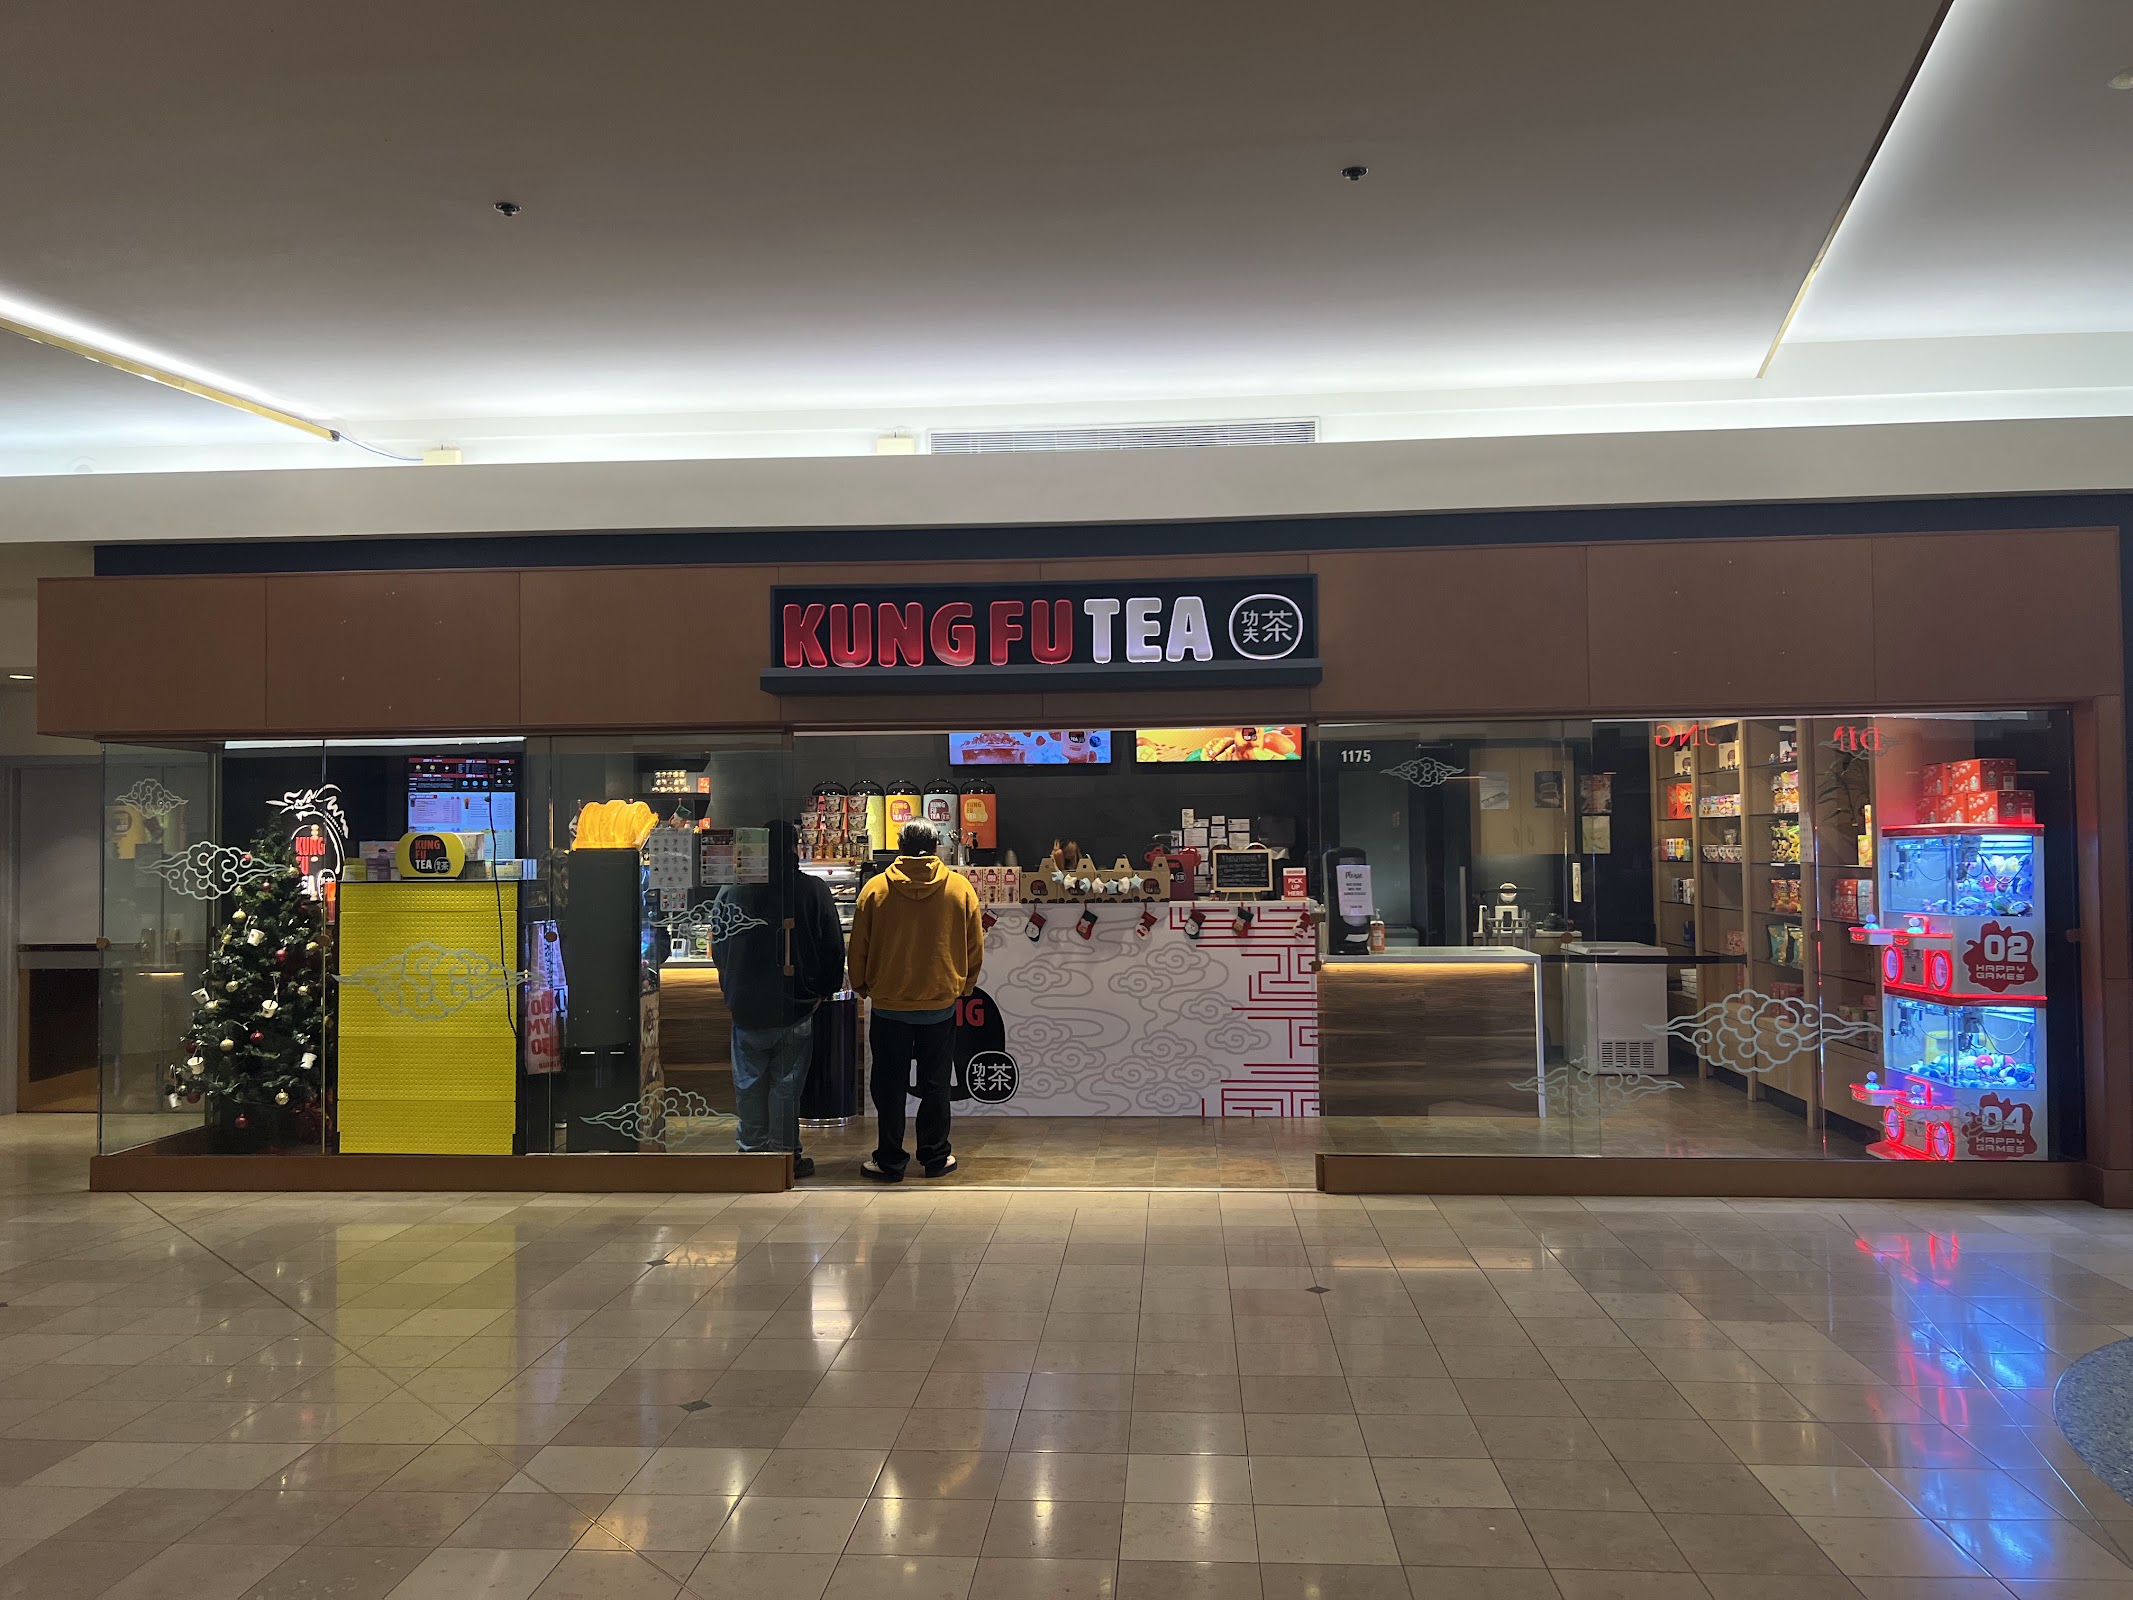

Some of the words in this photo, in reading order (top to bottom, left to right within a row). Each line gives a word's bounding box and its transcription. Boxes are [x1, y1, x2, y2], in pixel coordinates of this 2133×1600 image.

[782, 601, 977, 668] KUNG
[989, 598, 1073, 666] FU
[1083, 595, 1213, 664] TEA
[1241, 609, 1293, 644] 功夫茶
[1341, 750, 1371, 763] 1175
[295, 836, 326, 855] KUNG
[415, 839, 441, 850] KUNG
[415, 849, 427, 859] FU
[415, 859, 432, 869] TEA
[1984, 934, 2028, 962] 02
[1976, 964, 2025, 973] HAPPY
[1976, 972, 2024, 980] GAMES
[972, 1063, 1012, 1092] 功夫茶
[1982, 1105, 2025, 1135] 04
[1976, 1136, 2025, 1145] HAPPY
[1976, 1145, 2024, 1153] GAMES
